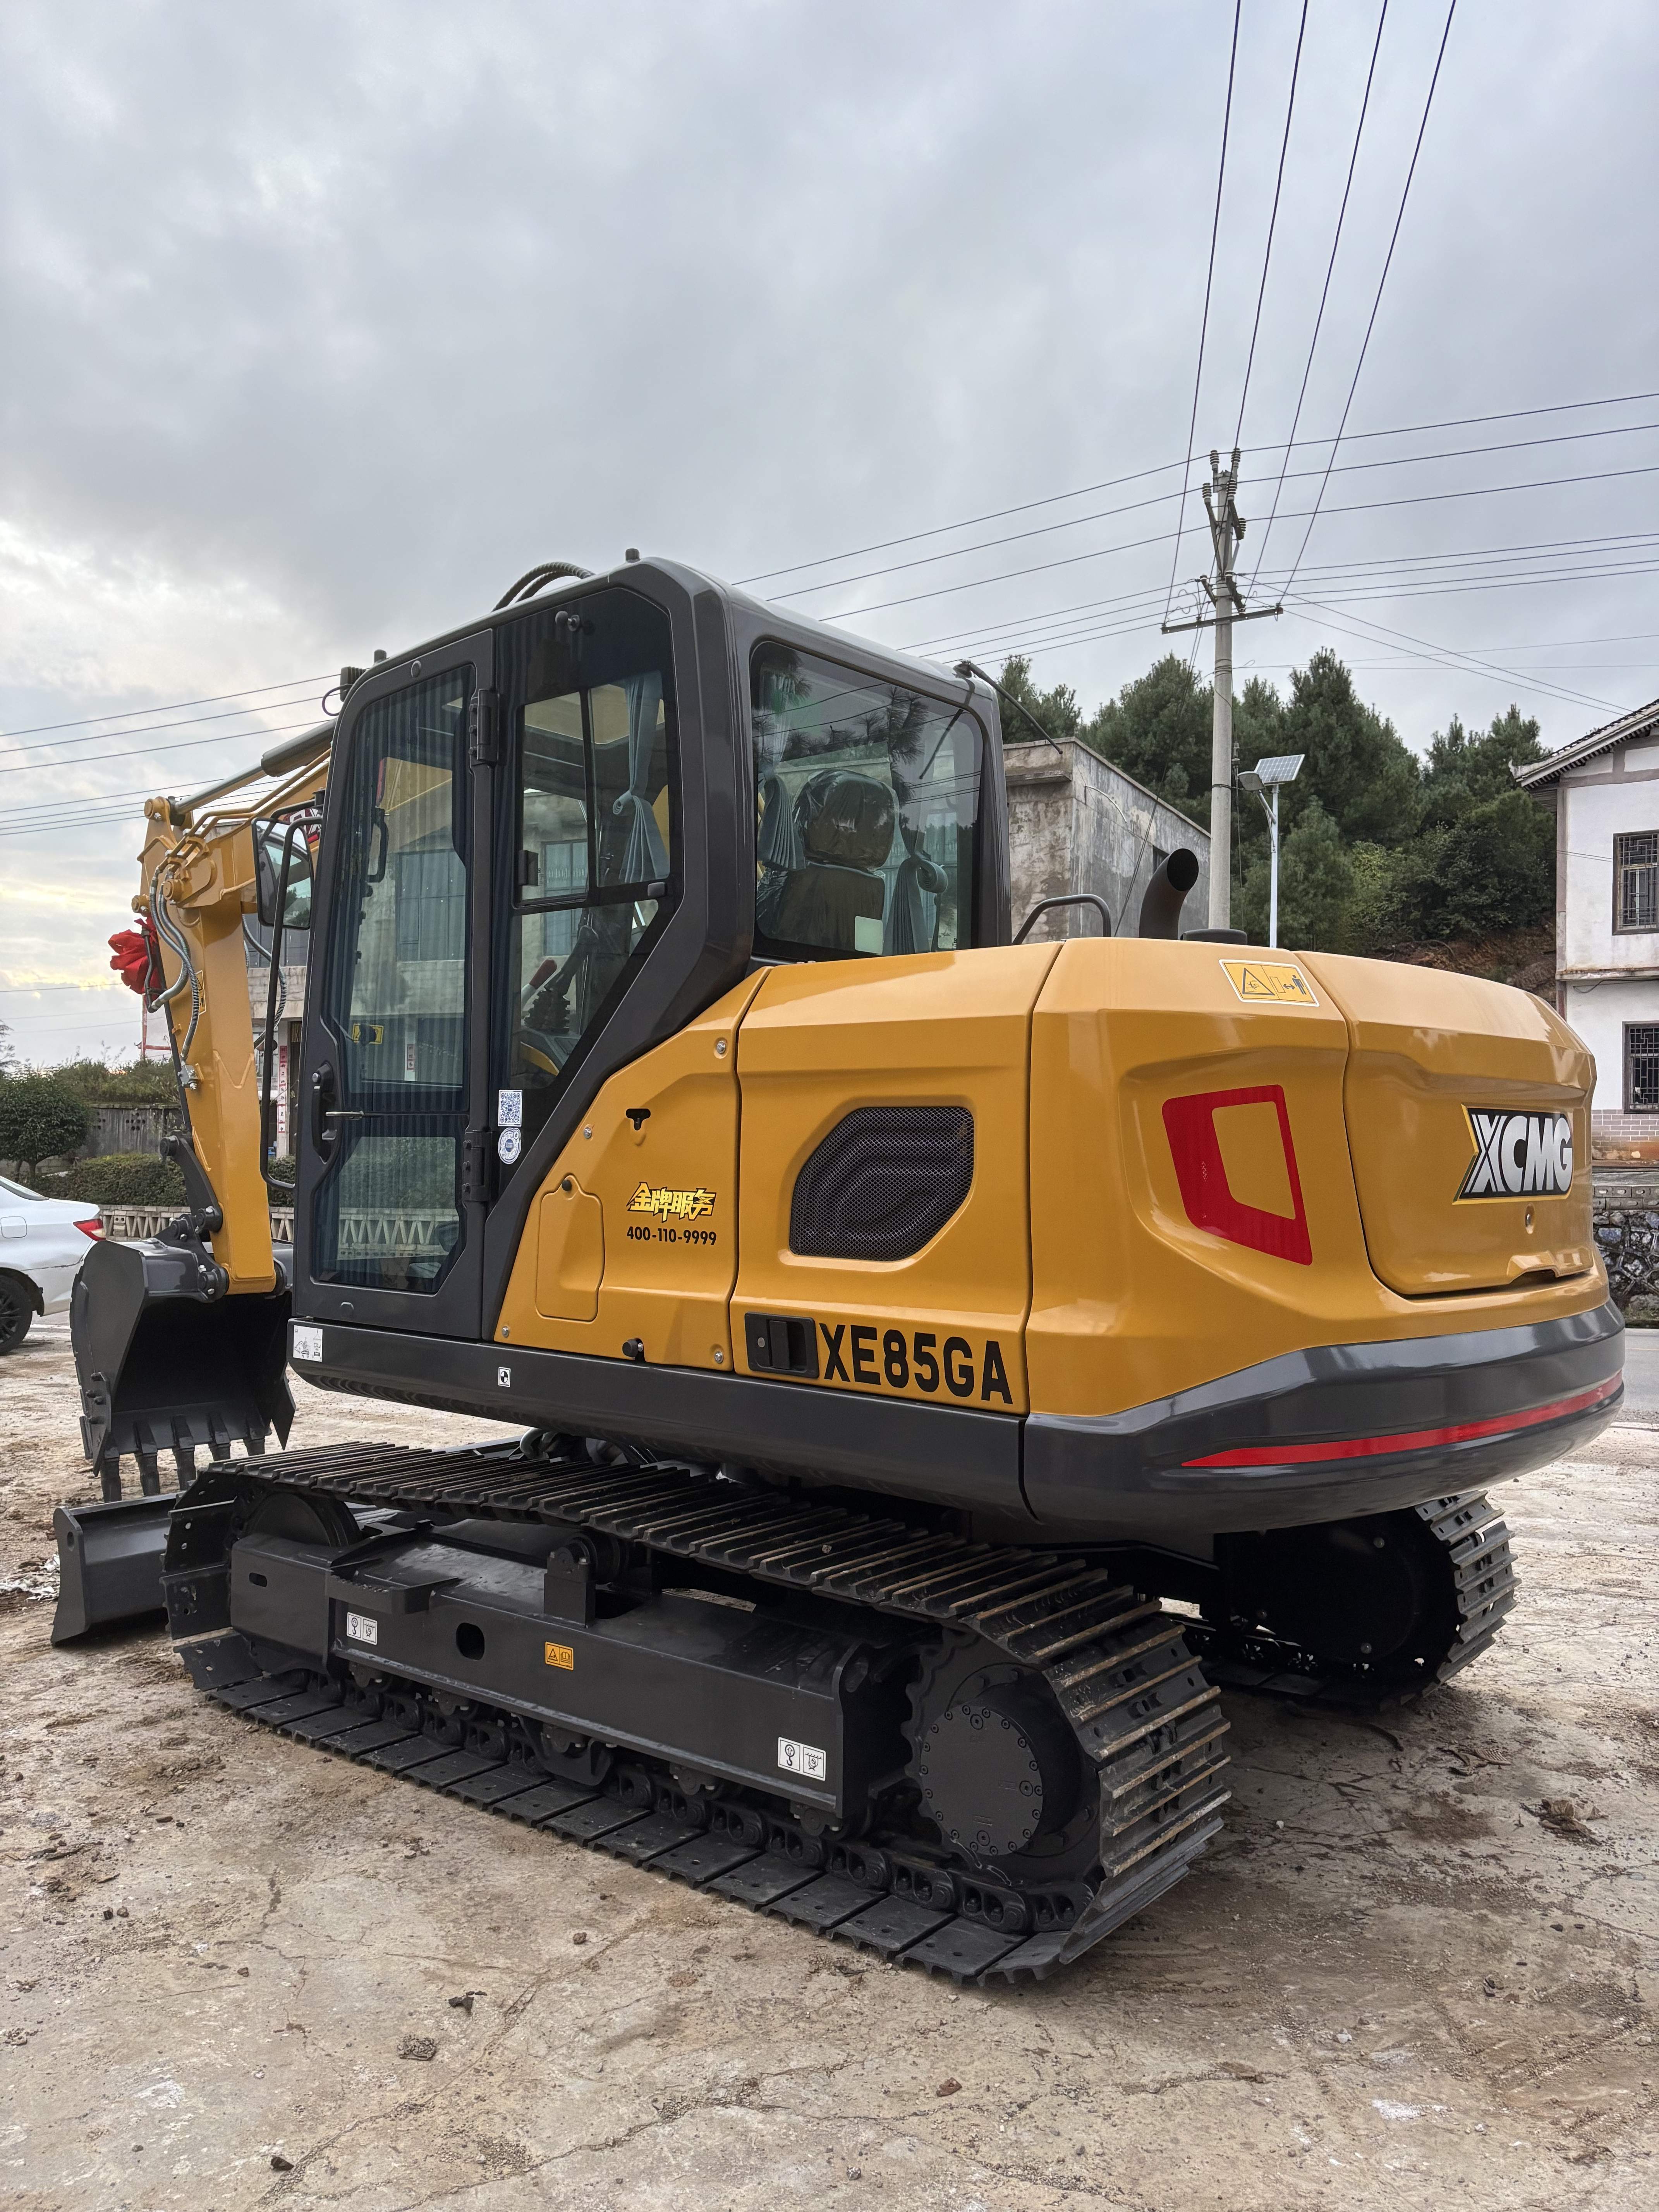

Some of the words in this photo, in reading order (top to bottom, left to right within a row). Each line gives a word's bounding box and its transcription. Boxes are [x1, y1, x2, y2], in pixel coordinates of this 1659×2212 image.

[1464, 1114, 1573, 1193] XCMG
[626, 1181, 717, 1223] 金牌服务
[627, 1226, 717, 1245] 400-110-9999
[819, 1323, 1013, 1405] XE85GA
